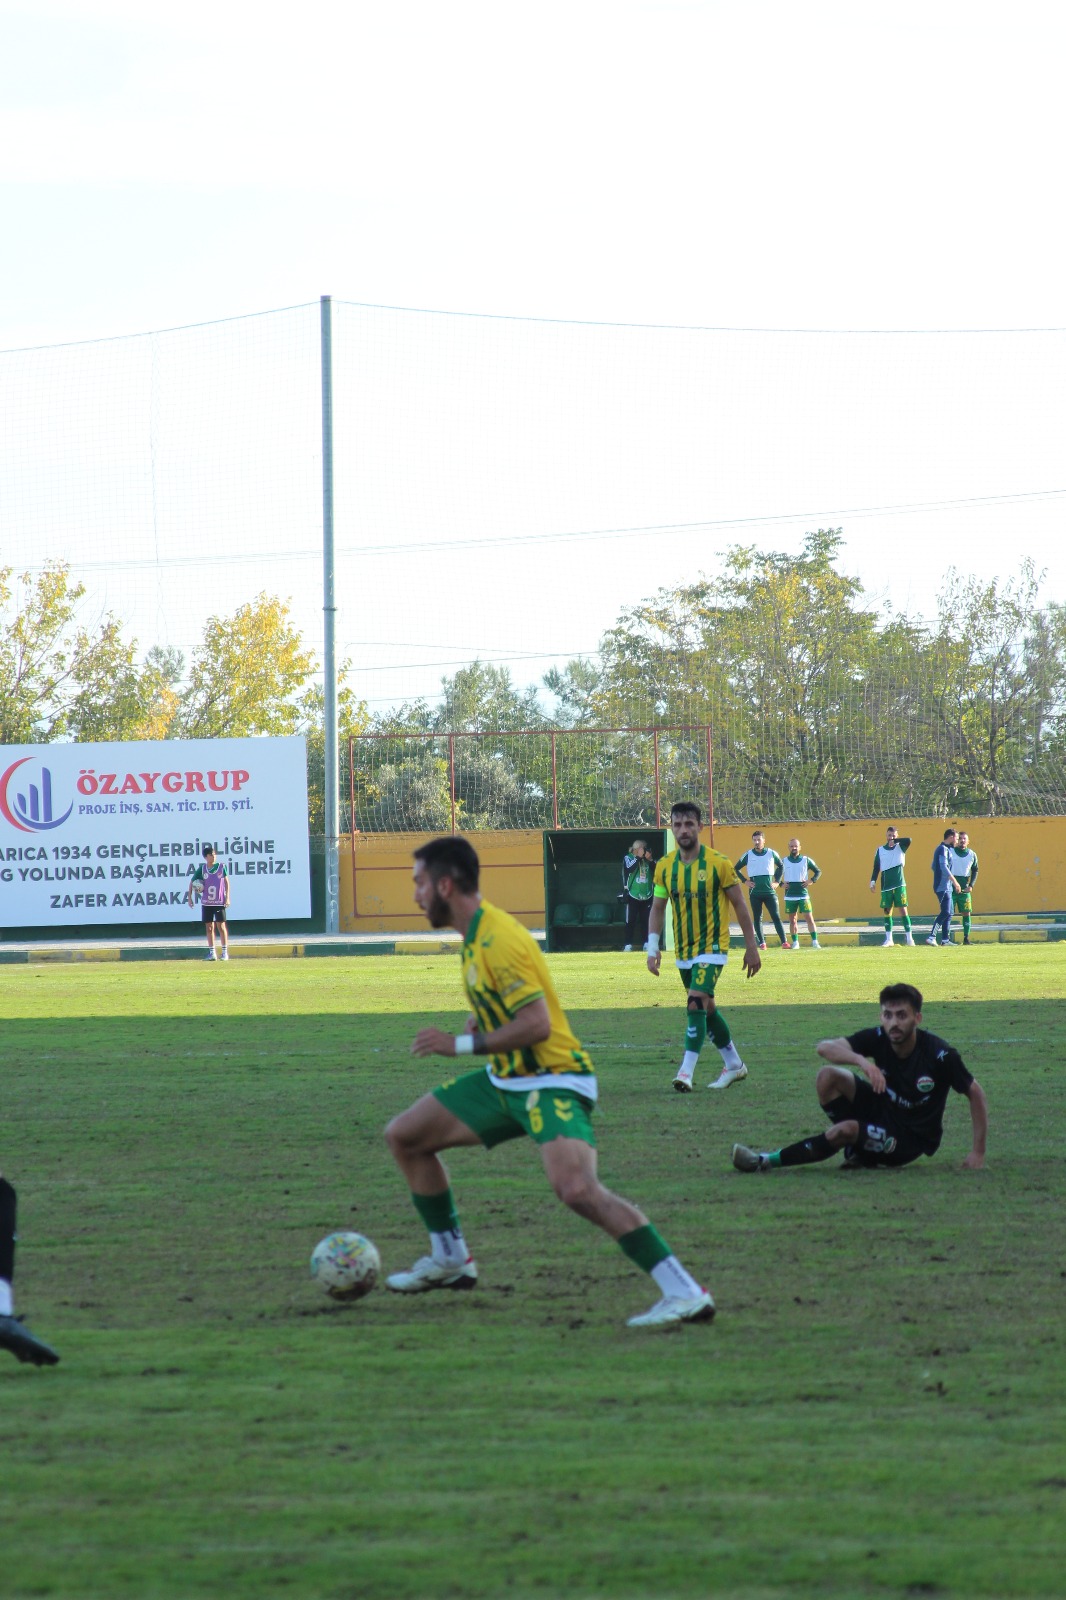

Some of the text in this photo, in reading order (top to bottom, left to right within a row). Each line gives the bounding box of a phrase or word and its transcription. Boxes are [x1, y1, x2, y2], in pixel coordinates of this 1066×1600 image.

[76, 769, 250, 796] ÖZAYGRUP
[78, 797, 254, 815] PROJE İNŞ. SAN. TİC. LTD. ŞTİ.
[52, 846, 91, 860] 1934
[18, 866, 106, 882] YOLUNDA
[110, 863, 206, 883] BAŞARILA
[228, 856, 292, 876] İLERİZ!
[50, 894, 108, 909] ZAFER
[207, 885, 217, 900] 9
[695, 968, 706, 986] 3
[529, 1106, 544, 1134] 6
